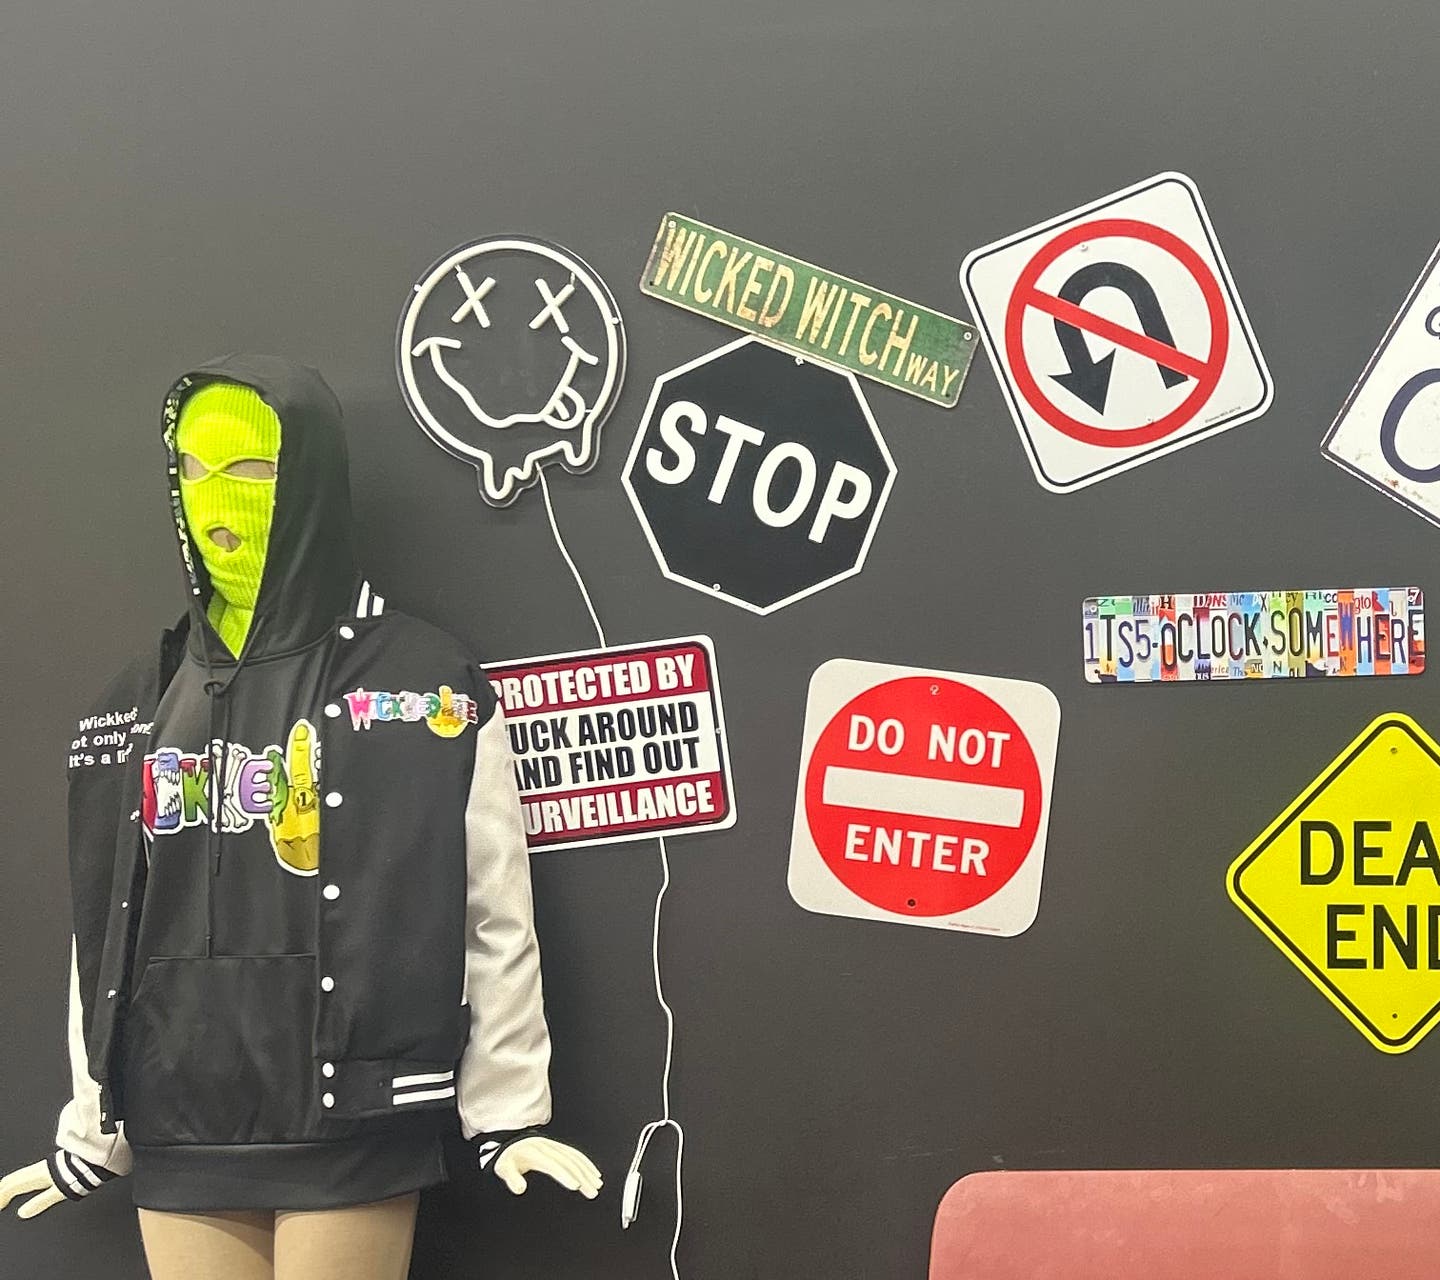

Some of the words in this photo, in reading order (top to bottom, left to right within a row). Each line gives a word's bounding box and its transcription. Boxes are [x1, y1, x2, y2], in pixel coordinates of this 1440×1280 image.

[653, 227, 795, 328] WICKED
[795, 275, 920, 378] WITCH
[903, 351, 960, 396] WAY
[645, 399, 873, 544] STOP
[655, 653, 695, 692] BY
[71, 735, 88, 751] ot
[93, 731, 127, 747] only
[506, 716, 572, 755] UCK
[578, 700, 700, 747] AROUND
[847, 714, 906, 756] DO
[927, 723, 1011, 769] NOT
[101, 753, 111, 765] a
[568, 745, 635, 785] FIND
[642, 736, 700, 775] OUT
[521, 779, 715, 836] URVEILLANCE
[844, 822, 990, 877] ENTER
